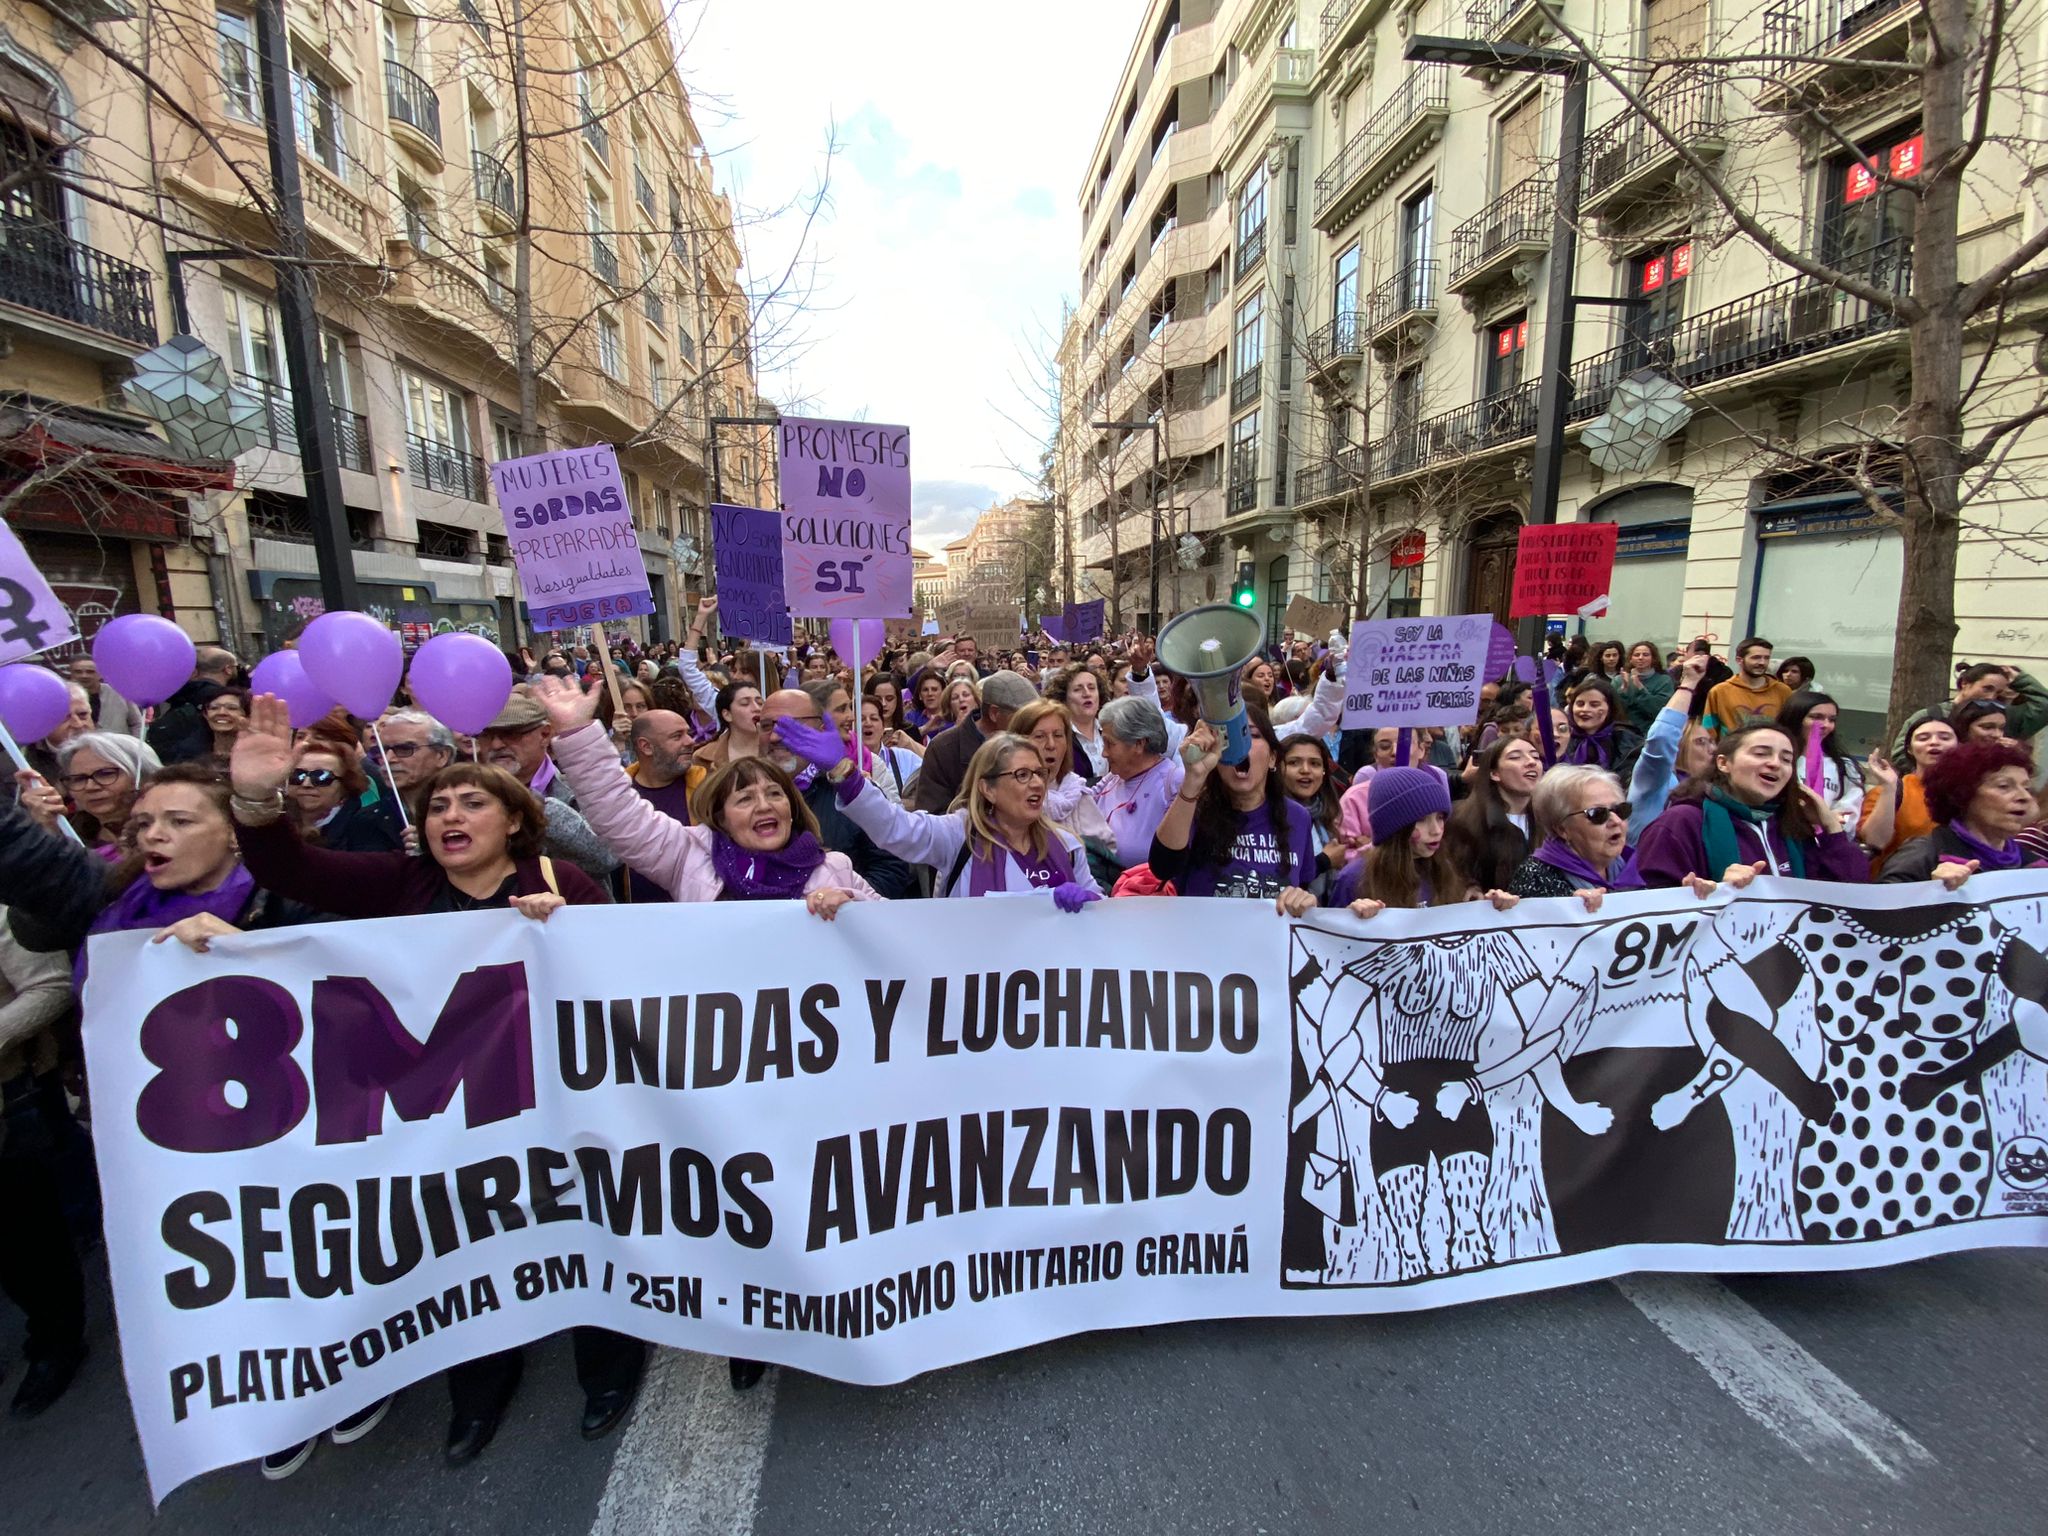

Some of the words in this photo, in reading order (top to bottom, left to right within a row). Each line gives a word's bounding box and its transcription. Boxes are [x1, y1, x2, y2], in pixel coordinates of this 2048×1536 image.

[783, 424, 908, 468] PROMESAS
[501, 452, 610, 493] MUJERES
[514, 486, 622, 529] SORDAS
[715, 511, 749, 545] NO
[517, 521, 637, 564] PREPARADAS
[786, 516, 909, 555] SOLUCIONES
[815, 554, 873, 594] SÍ
[1381, 643, 1462, 663] MAESTRA
[1395, 625, 1424, 642] SOY
[1427, 624, 1443, 641] LA
[1371, 669, 1390, 686] DE
[1395, 667, 1424, 683] LAS
[1429, 663, 1475, 683] NIÑAS
[1346, 693, 1373, 711] QUE
[1608, 919, 1698, 979] 8M
[136, 961, 536, 1154] 8M
[556, 983, 840, 1091] UNIDAS
[865, 979, 906, 1063] Y
[927, 968, 1259, 1057] LUCHANDO
[161, 1143, 774, 1310] SEGUIREMOS
[805, 1106, 1251, 1252] AVANZANDO
[169, 1274, 501, 1424] PLATAFORMA
[513, 1254, 588, 1301] 8M
[626, 1271, 702, 1319] 25N
[743, 1261, 955, 1339] FEMINISMO
[968, 1240, 1123, 1303] UNITARIO
[1135, 1224, 1249, 1276] GRANÁ
